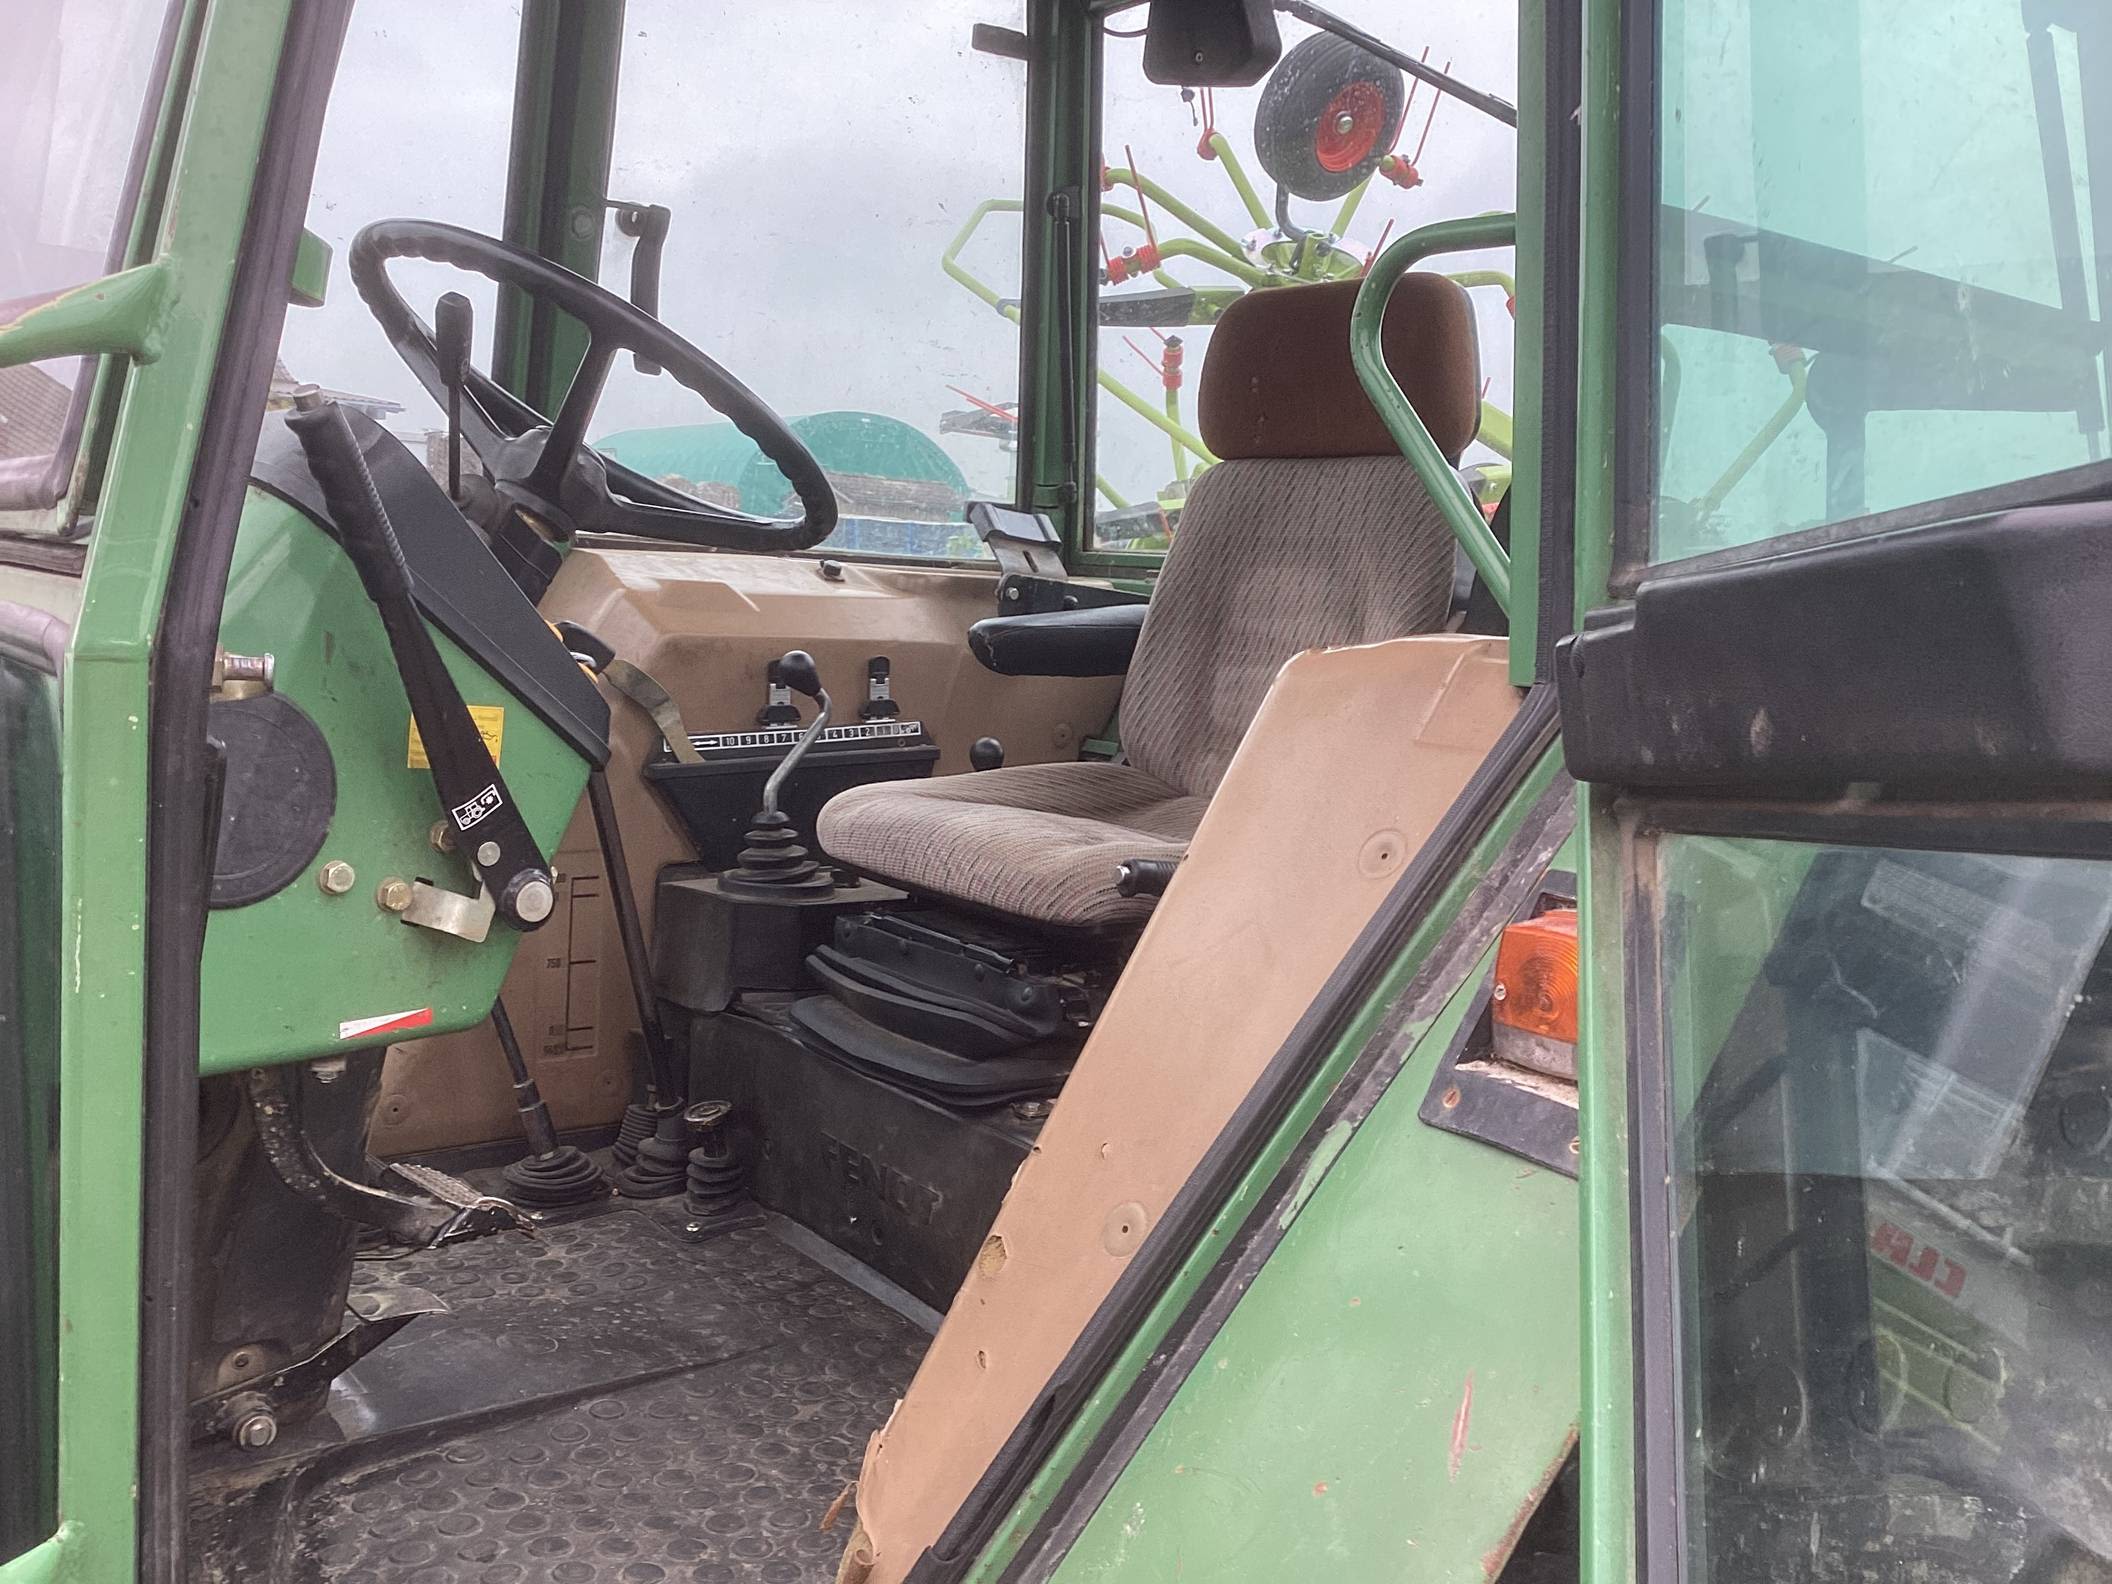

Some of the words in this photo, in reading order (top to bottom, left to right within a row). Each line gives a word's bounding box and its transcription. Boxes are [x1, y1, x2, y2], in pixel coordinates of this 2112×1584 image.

[725, 736, 736, 747] 10
[745, 735, 752, 745] 9
[763, 734, 770, 744] 8
[781, 733, 788, 743] 7
[832, 729, 839, 738] 4
[848, 728, 855, 737] 3
[865, 727, 871, 736] 2
[819, 1129, 944, 1226] FENDT
